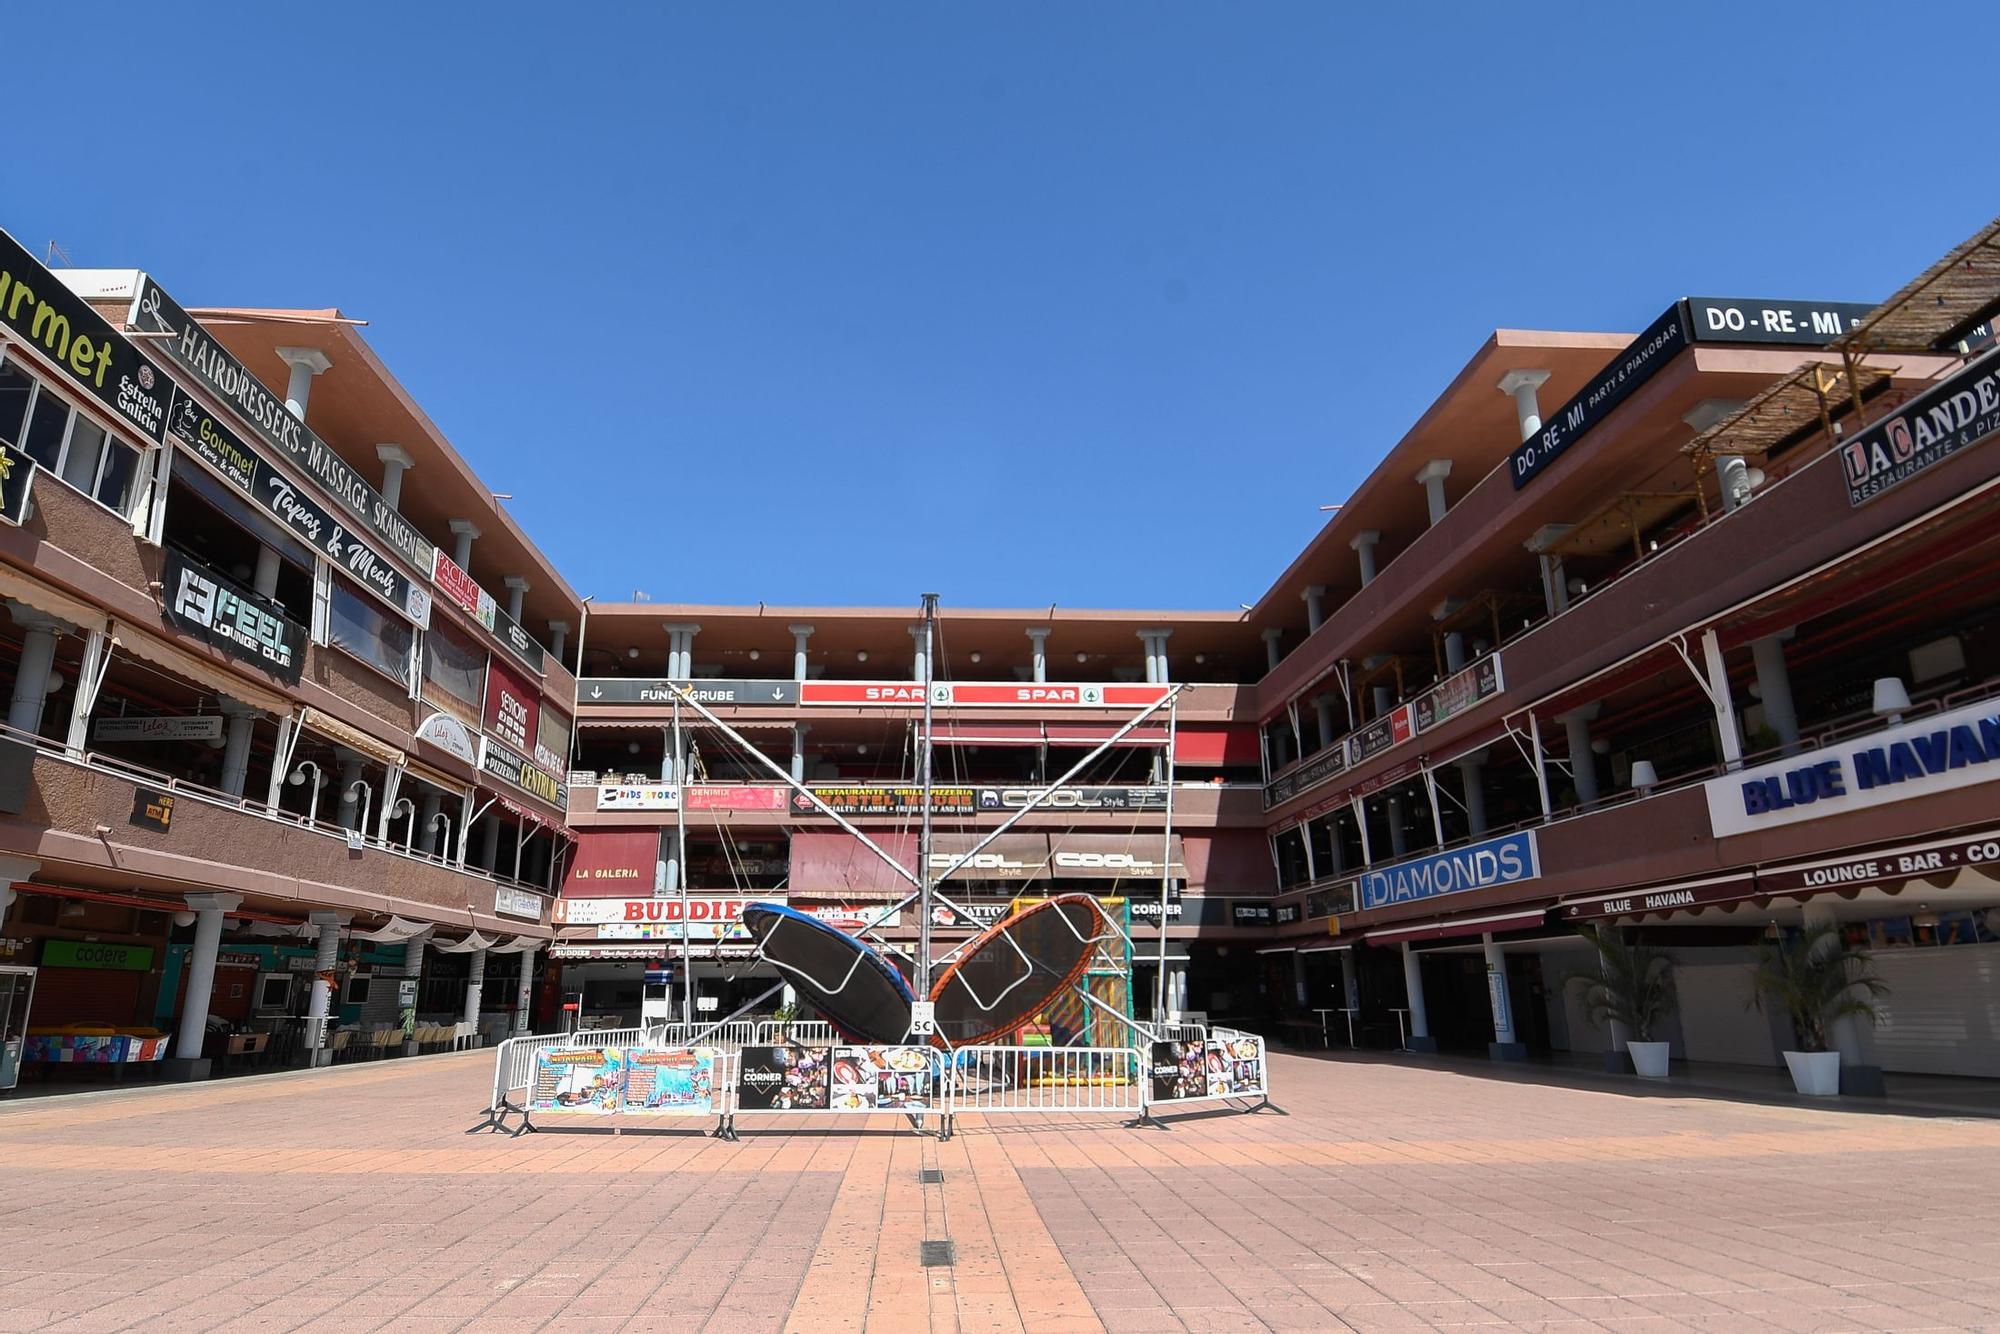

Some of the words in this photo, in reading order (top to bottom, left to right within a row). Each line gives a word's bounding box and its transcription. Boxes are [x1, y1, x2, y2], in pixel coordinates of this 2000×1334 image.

[1706, 307, 1745, 330] DO
[1761, 309, 1797, 332] RE
[1811, 311, 1842, 335] MI
[117, 391, 158, 434] Galicia
[118, 374, 162, 420] Estrella
[1517, 448, 1535, 475] DO
[1542, 424, 1561, 453] RE
[1567, 402, 1584, 431] MI
[1589, 377, 1616, 408] PARTY
[1618, 370, 1626, 382] &
[1626, 323, 1678, 375] PIANOBAR
[1892, 368, 2000, 458] CANDE
[179, 323, 302, 453] HAIRDRESSER'S
[308, 445, 367, 514] MASSAGE
[372, 501, 418, 559] SKANSEN
[200, 418, 254, 476] Gourmet
[198, 440, 218, 464] Tapas
[220, 458, 227, 471] &
[228, 465, 250, 489] Meals
[1851, 441, 1953, 503] RESTAURANTE
[1959, 432, 1969, 445] &
[269, 476, 322, 539] Tapas
[327, 525, 343, 559] &
[348, 543, 397, 598] Meals
[437, 552, 479, 600] PACIFIC
[215, 587, 292, 657] FEEL
[212, 619, 258, 653] LOUNGE
[262, 645, 291, 668] CLUB
[690, 690, 735, 700] GRUBE
[866, 688, 925, 699] SPAR
[1017, 689, 1076, 700] SPAR
[486, 740, 521, 770] RESTAURANTE
[489, 758, 516, 782] PIZZERIA
[520, 763, 558, 802] CENTRUM
[620, 791, 641, 799] KIDS
[815, 788, 885, 796] RESTAURANTE
[894, 788, 924, 796] GRILL
[930, 788, 974, 796] PIZZERIA
[1003, 790, 1102, 807] COOL
[1104, 797, 1125, 808] Style
[1742, 760, 1846, 816] BLUE
[575, 869, 589, 879] LA
[595, 869, 639, 879] GALERIA
[999, 868, 1022, 877] Style
[1131, 868, 1154, 877] Style
[928, 853, 1023, 868] COOL
[1055, 853, 1153, 868] COOL
[1370, 843, 1523, 905] DIAMONDS
[1804, 862, 1880, 887] LOUNGE
[1898, 851, 1943, 873] BAR
[624, 901, 753, 920] BUDDIE
[1603, 899, 1632, 913] BLUE
[1646, 890, 1695, 908] HAVANA
[76, 946, 128, 962] codere
[743, 1072, 782, 1083] CORNER
[1154, 1066, 1178, 1075] CORNER
